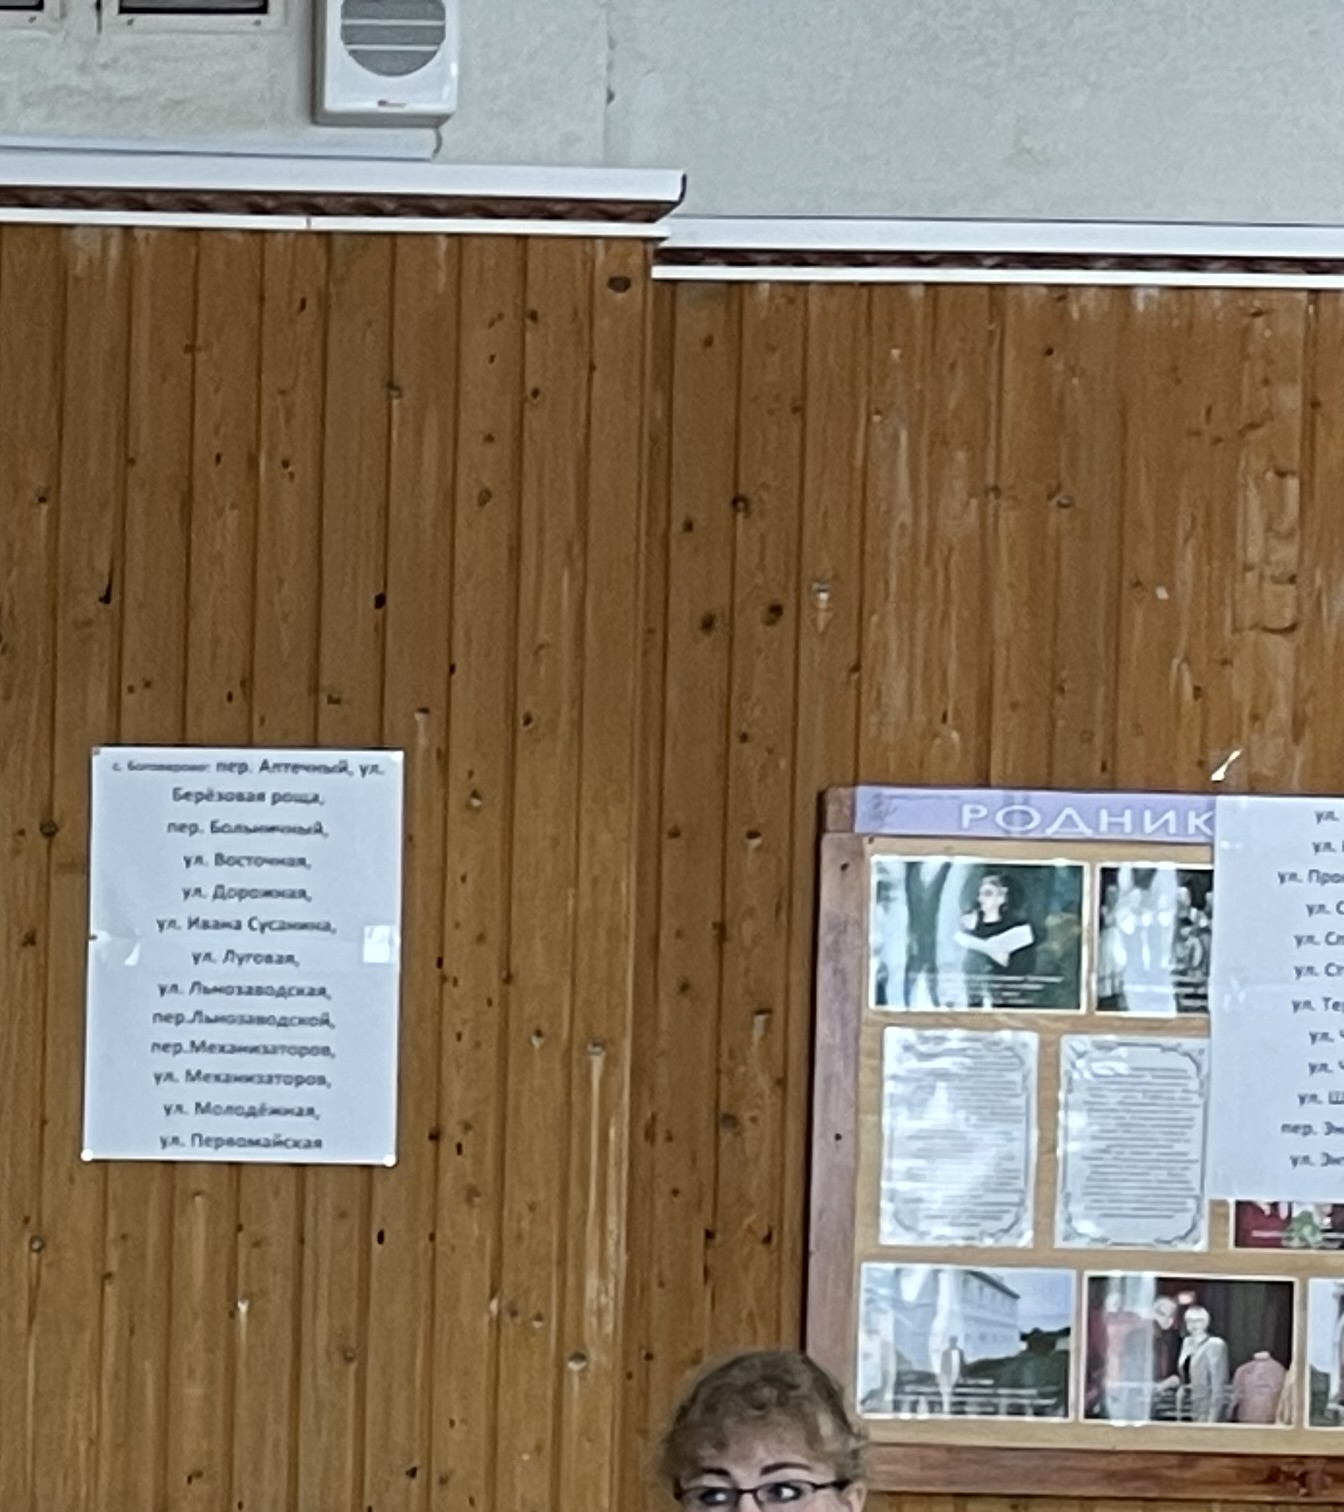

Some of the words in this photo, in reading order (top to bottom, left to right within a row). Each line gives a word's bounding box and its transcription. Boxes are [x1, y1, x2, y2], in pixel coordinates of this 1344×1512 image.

[216, 762, 252, 776] пер.
[258, 758, 355, 778] Аптечный,
[172, 786, 266, 805] Берёзовая
[271, 792, 326, 806] роща,
[166, 822, 205, 837] пер.
[183, 854, 209, 870] ул.
[214, 852, 312, 870] Восточная,
[181, 887, 207, 901] ул.
[211, 883, 312, 903] Дорожная,
[156, 918, 182, 934] ул.
[187, 915, 242, 931] Ивана
[247, 915, 337, 935] Сусанина,
[191, 951, 217, 966] ул.
[222, 949, 300, 968] Луговая,
[157, 983, 183, 998] ул.
[189, 980, 332, 1001] Льнозаводская,
[153, 1071, 179, 1086] ул.
[185, 1068, 332, 1089] Механизаторов,
[163, 1104, 189, 1118] ул.
[194, 1101, 321, 1121] Молодёжная,
[159, 1135, 186, 1150] ул.
[190, 1132, 323, 1151] Первомайская
